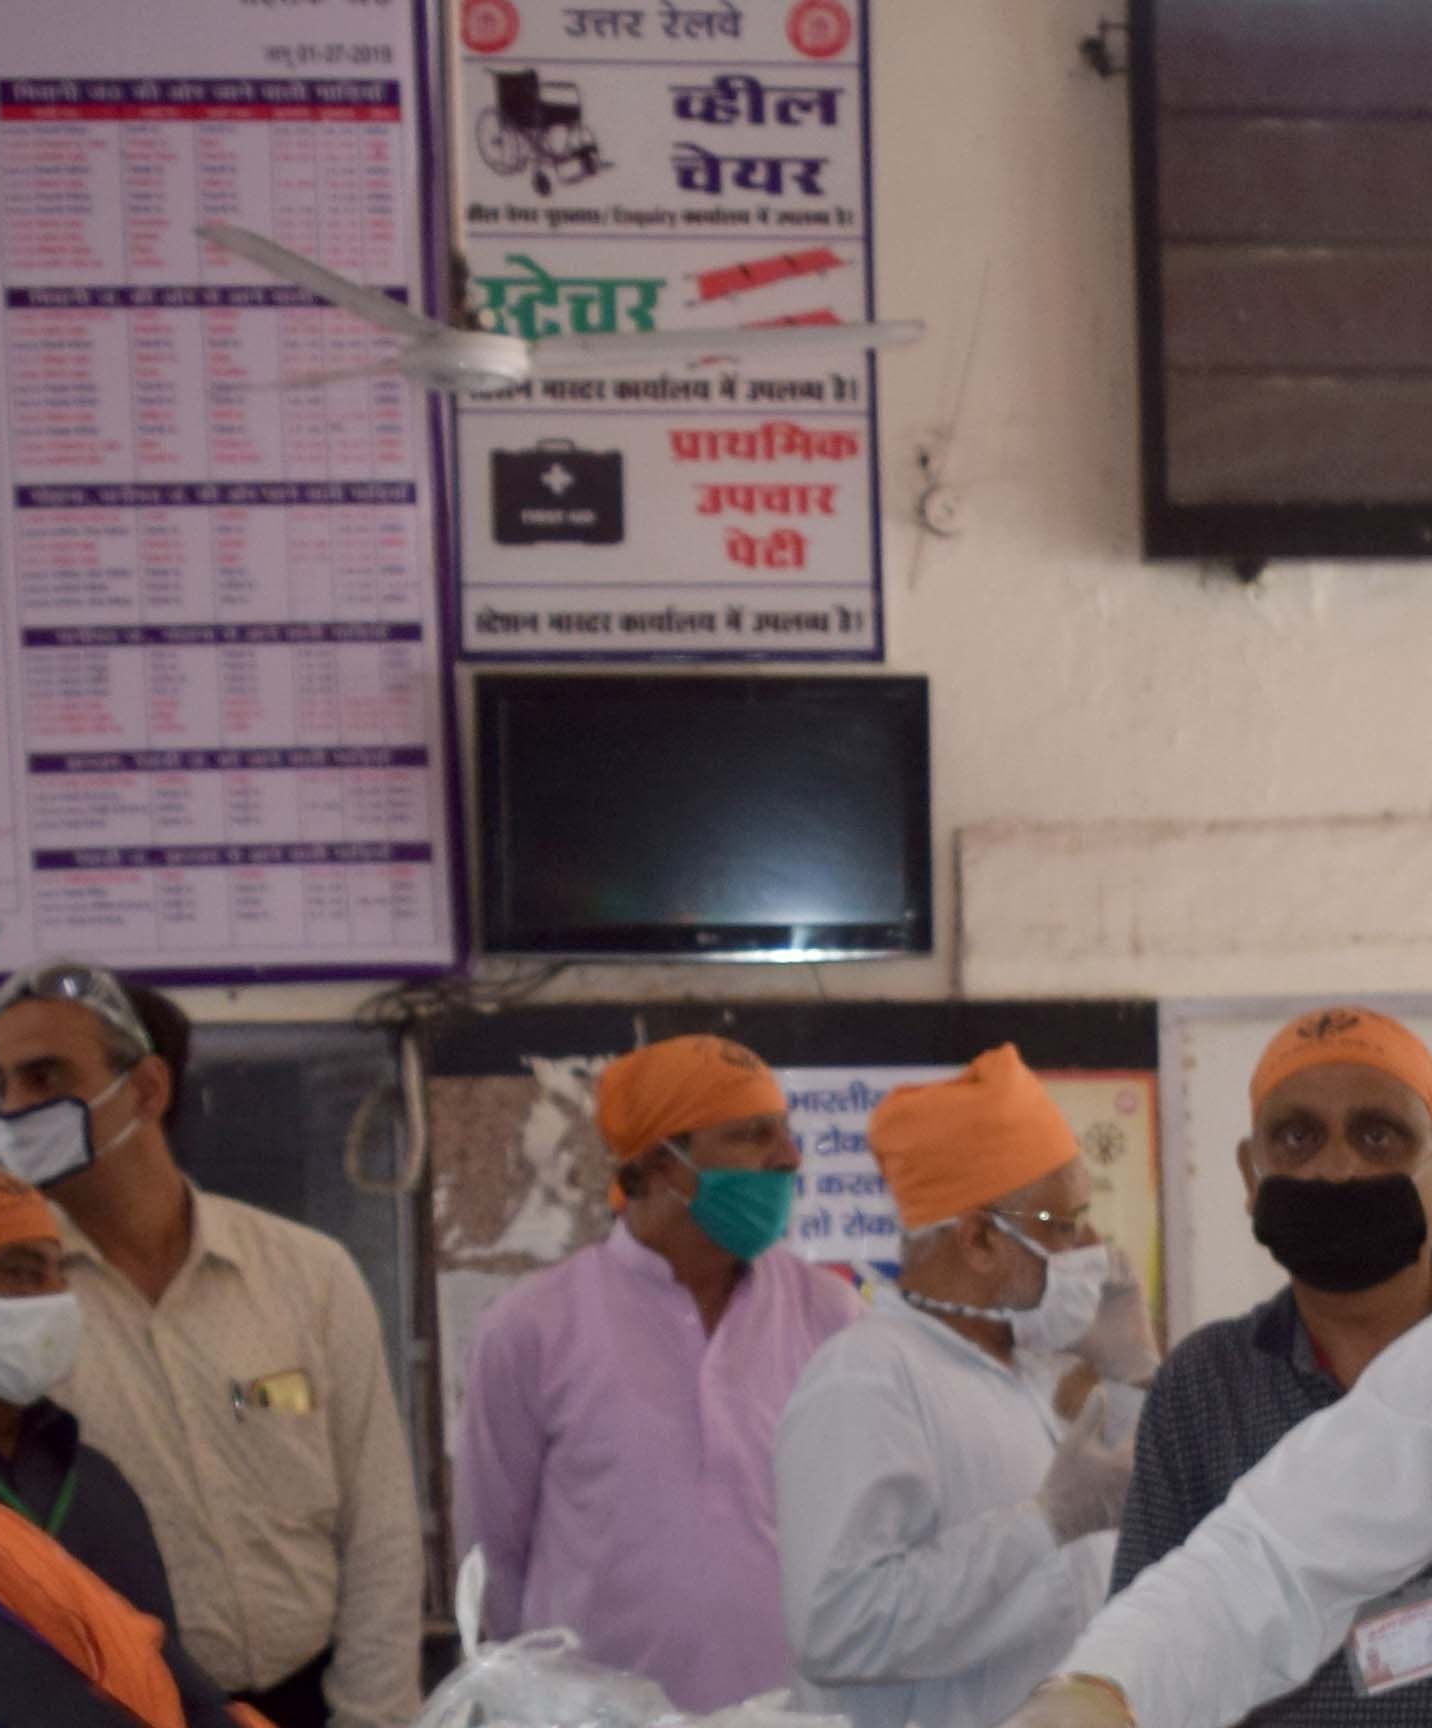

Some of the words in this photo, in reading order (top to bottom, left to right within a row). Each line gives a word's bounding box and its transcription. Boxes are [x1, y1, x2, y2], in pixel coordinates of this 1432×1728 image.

[564, 8, 644, 39] उत्तर
[662, 0, 742, 39] रेलवे
[669, 74, 844, 126] व्हील
[671, 143, 828, 196] चेयर
[669, 420, 860, 463] प्राथमिक
[695, 483, 837, 517] उपचार
[724, 528, 809, 571] पेटी
